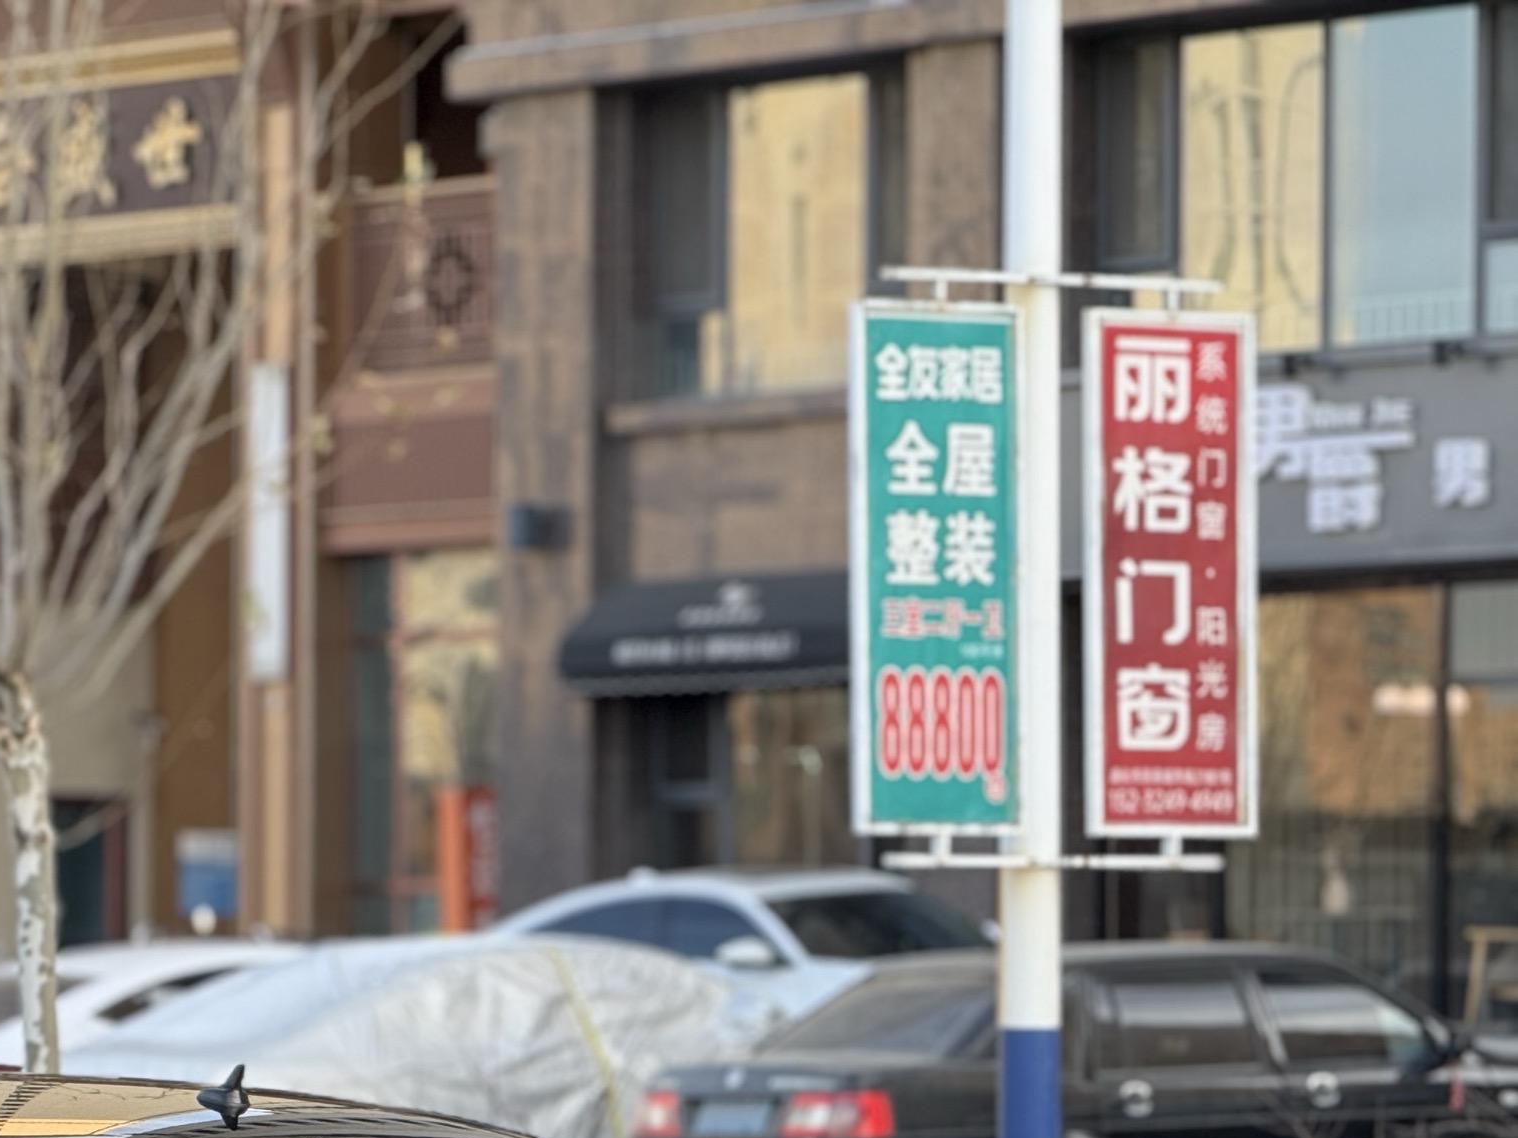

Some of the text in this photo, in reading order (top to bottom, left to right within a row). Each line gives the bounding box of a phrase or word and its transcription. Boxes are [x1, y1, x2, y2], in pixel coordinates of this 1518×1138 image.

[875, 342, 1004, 404] 全友家居
[885, 419, 998, 497] 全屋
[885, 509, 997, 587] 整装
[1112, 334, 1194, 752] 丽格门窗
[876, 664, 1008, 782] 88800
